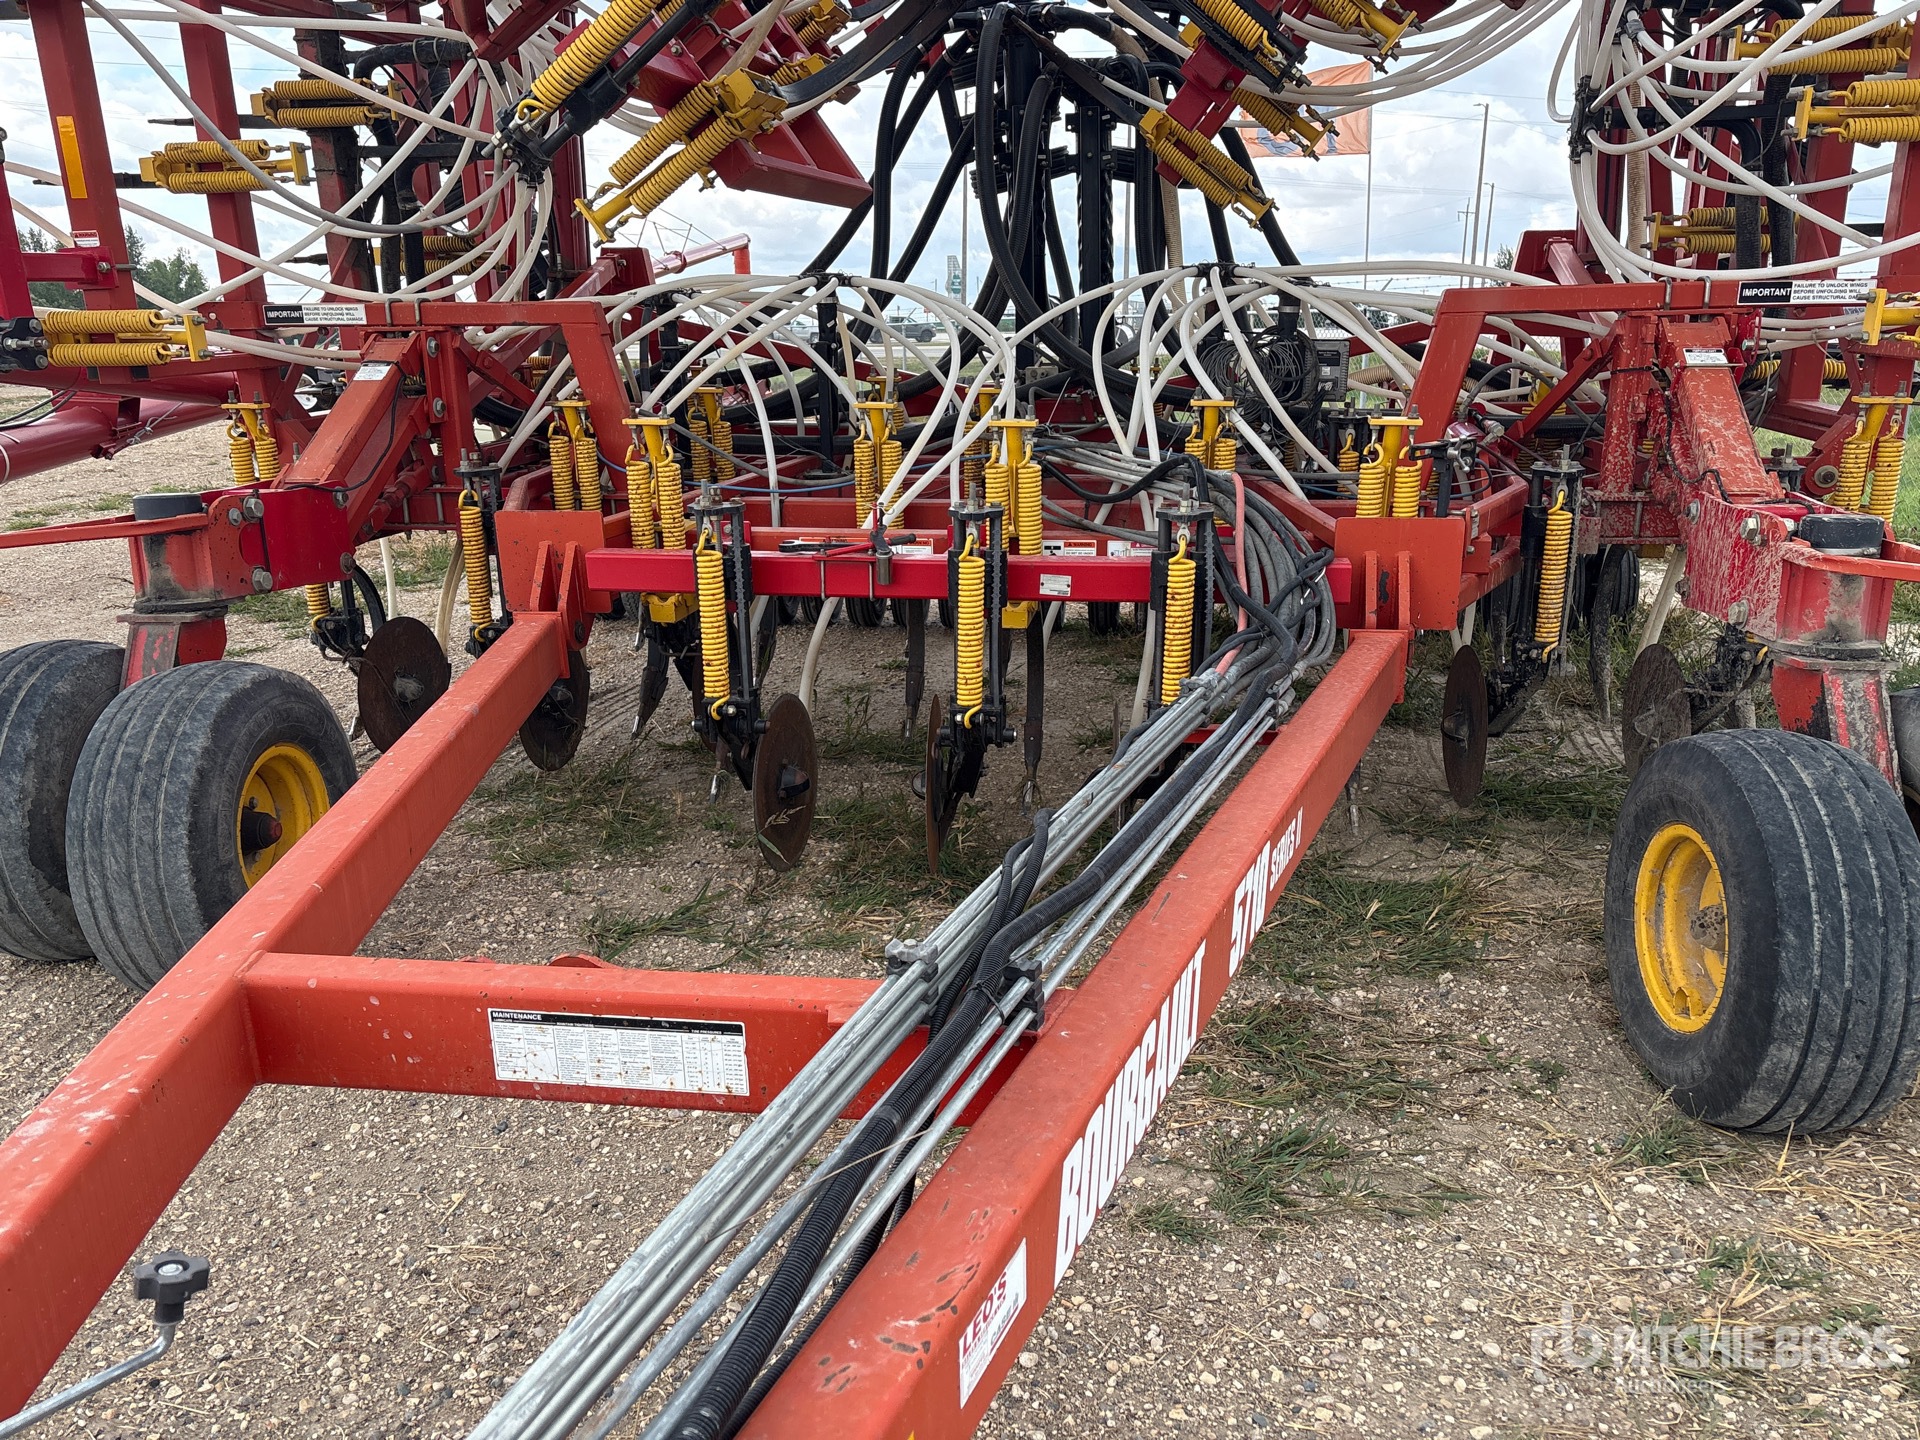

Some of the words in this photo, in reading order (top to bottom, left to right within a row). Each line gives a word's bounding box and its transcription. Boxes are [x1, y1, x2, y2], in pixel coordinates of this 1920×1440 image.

[1742, 288, 1791, 297] IMPORTANT
[267, 310, 303, 318] IMPORTANT
[492, 1012, 542, 1021] MAINTENANCE
[1054, 939, 1207, 1290] BOURGAULT
[1229, 840, 1271, 978] 5710
[1270, 818, 1296, 892] SERIES
[1296, 806, 1304, 850] II
[962, 1271, 1007, 1357] LEO'S
